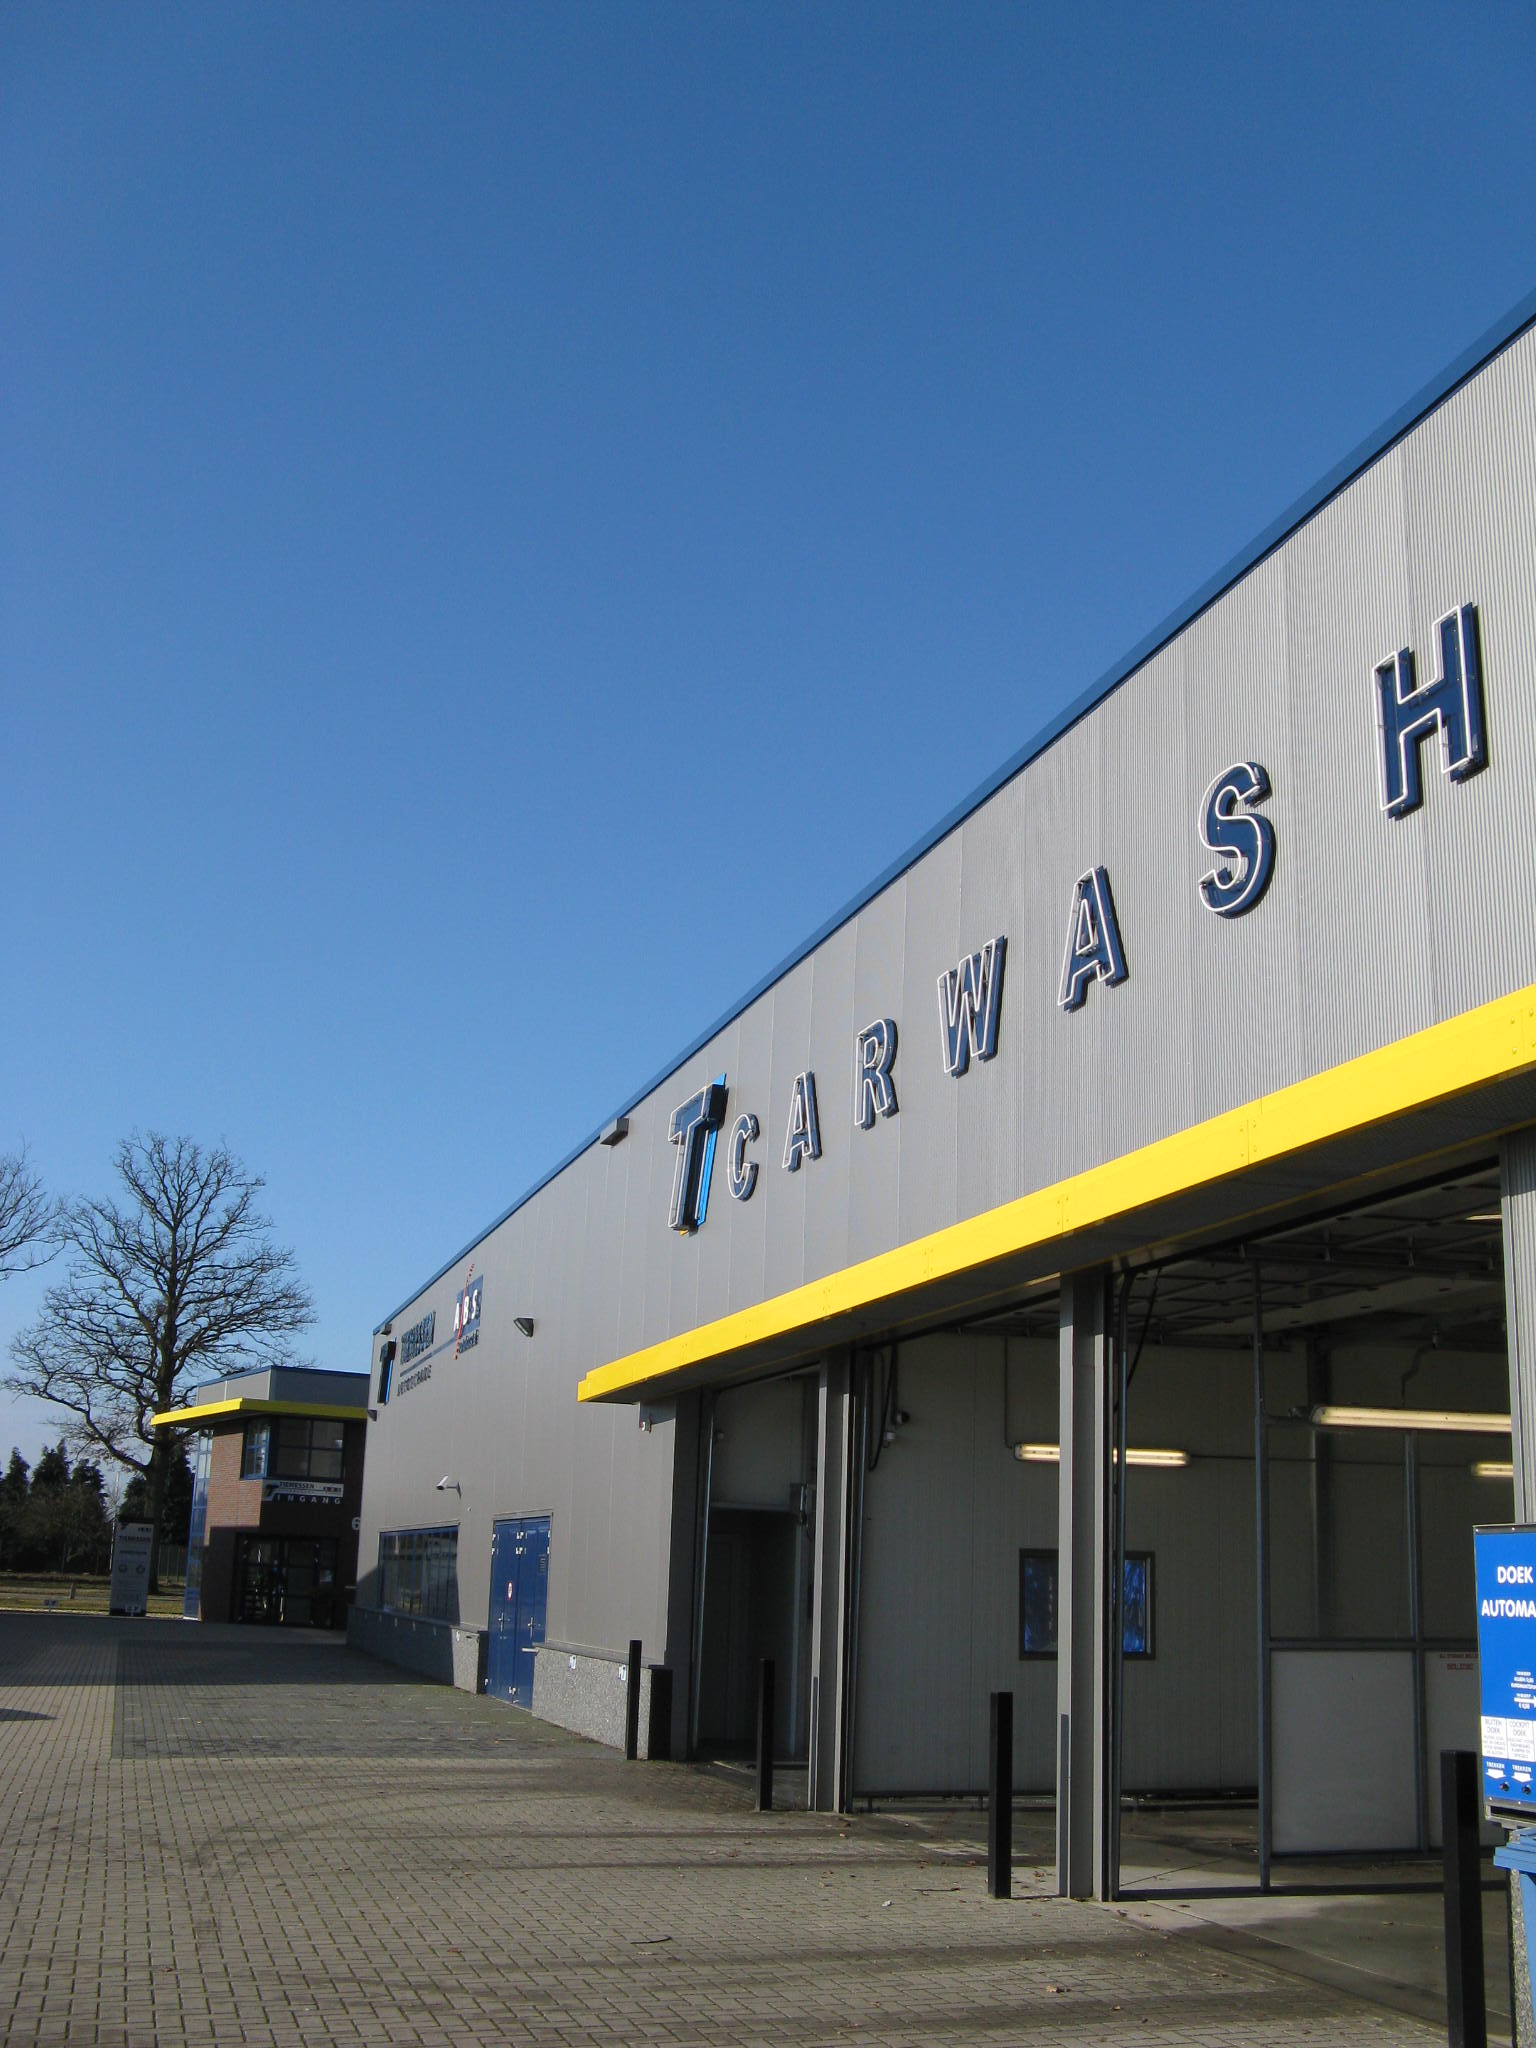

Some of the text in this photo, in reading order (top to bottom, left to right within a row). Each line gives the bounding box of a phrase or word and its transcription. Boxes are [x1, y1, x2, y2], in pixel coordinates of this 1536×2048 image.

[727, 602, 1488, 1201] CARWASH
[453, 1288, 478, 1332] ABS
[276, 1494, 341, 1505] INGANG
[1497, 1565, 1534, 1584] DOEK
